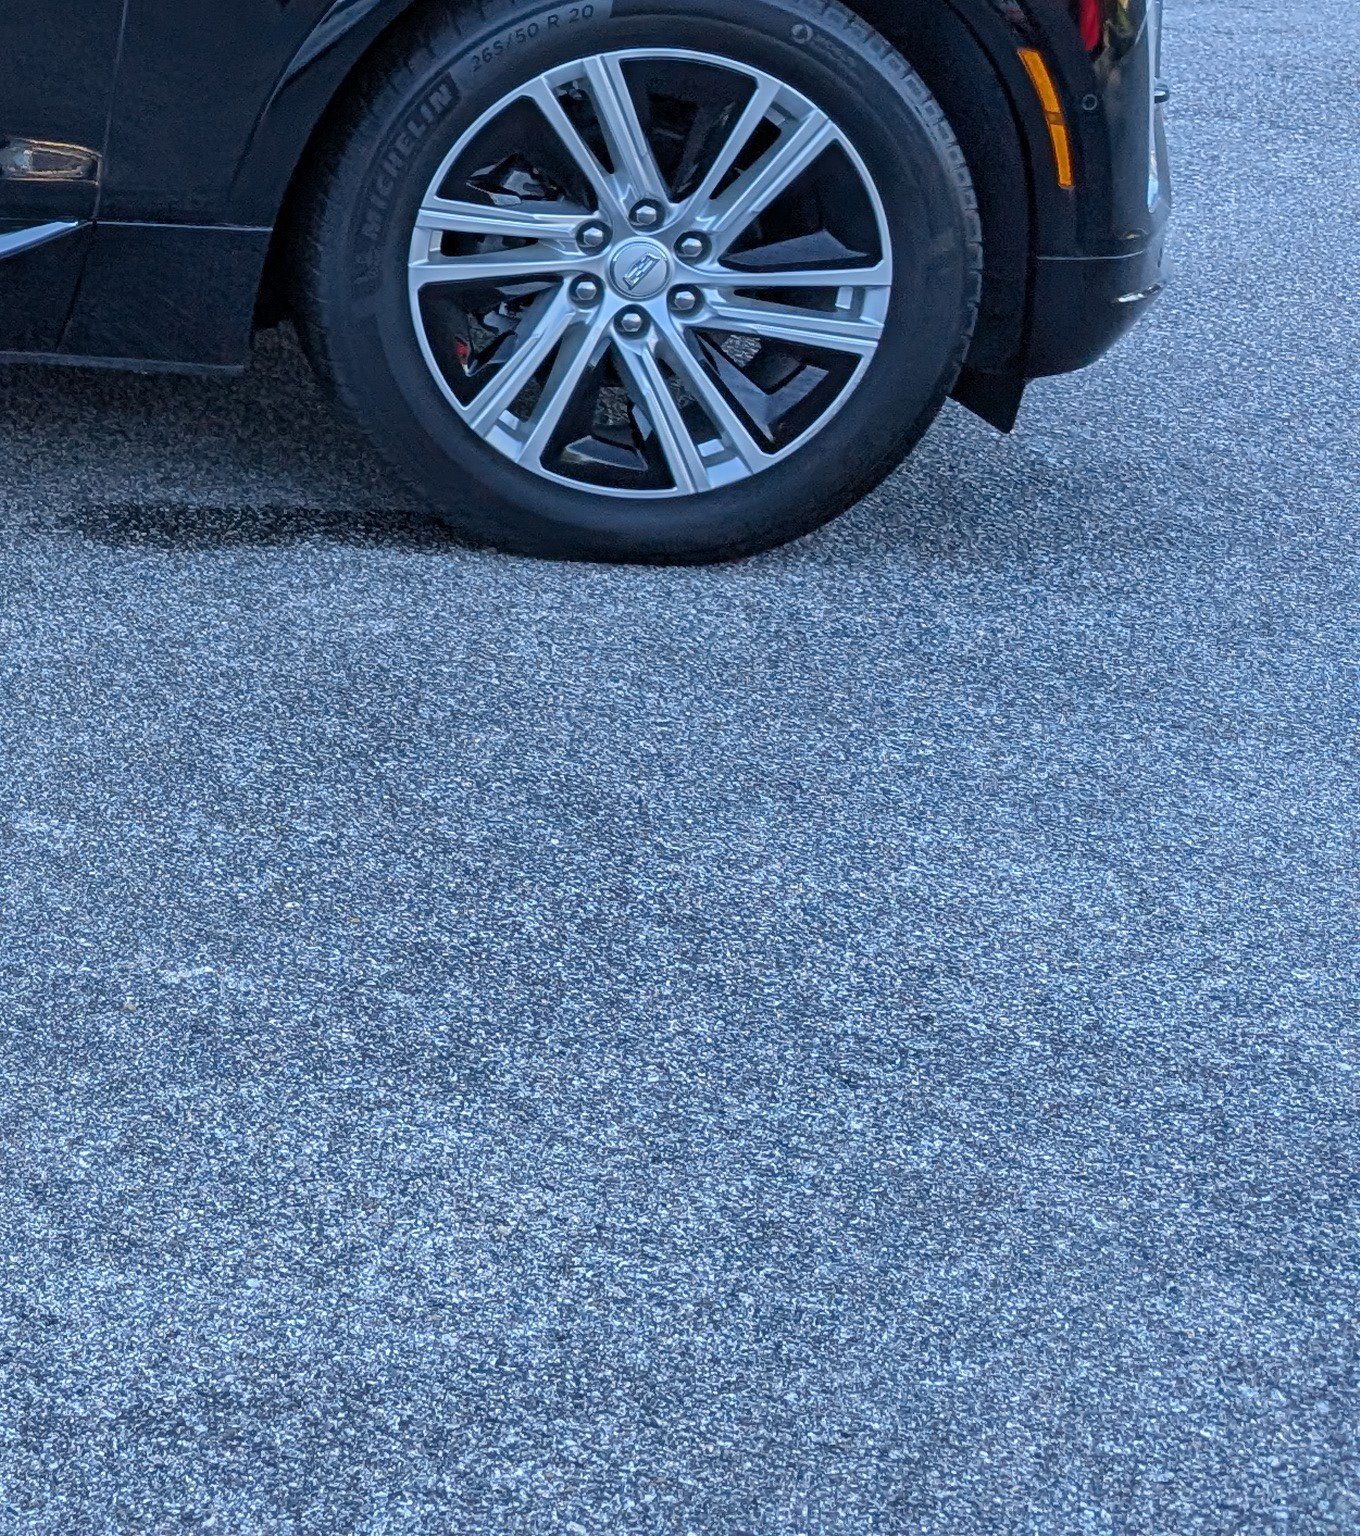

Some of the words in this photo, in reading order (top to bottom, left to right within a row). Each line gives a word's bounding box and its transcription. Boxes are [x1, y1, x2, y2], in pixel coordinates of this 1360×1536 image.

[547, 14, 561, 29] R
[568, 4, 594, 24] 20
[360, 83, 454, 240] MICHELIN
